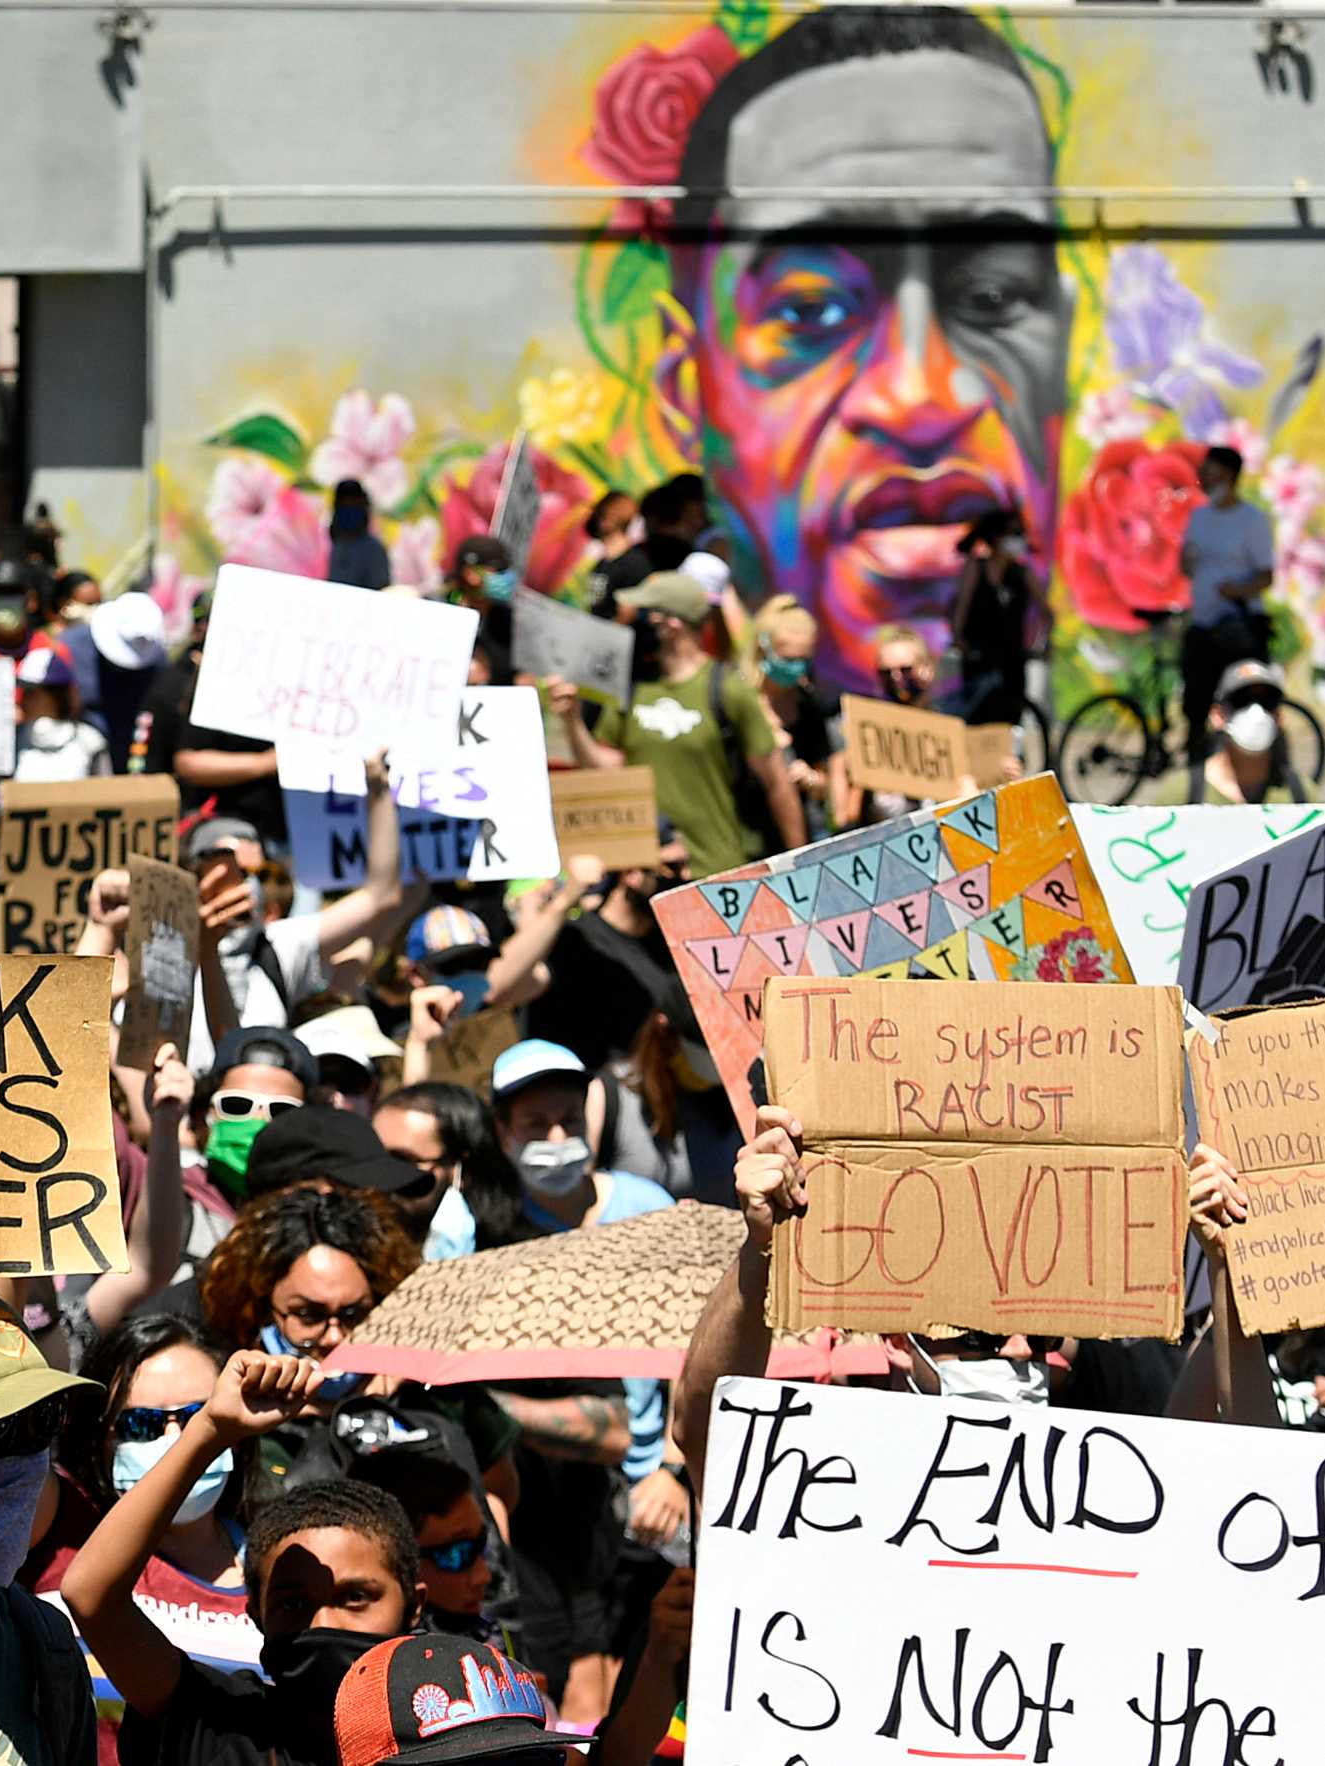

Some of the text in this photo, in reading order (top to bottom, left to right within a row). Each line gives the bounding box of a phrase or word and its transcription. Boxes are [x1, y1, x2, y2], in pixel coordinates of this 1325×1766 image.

[858, 719, 956, 783] ENOUGH
[324, 766, 489, 815] LVES
[330, 817, 508, 881] MTTER
[722, 804, 996, 919] BLACK
[3, 900, 77, 954] BRE
[711, 880, 986, 976] LIVES
[743, 877, 1081, 1022] MTER
[780, 987, 1145, 1086] The system is
[1247, 1032, 1292, 1067] you
[893, 1077, 1075, 1139] RACIST
[1222, 1072, 1321, 1113] makes
[794, 1157, 1179, 1297] GO VOTE!
[1245, 1182, 1295, 1218] black
[710, 1385, 864, 1540] The
[884, 1413, 1166, 1556] END
[723, 1605, 843, 1731] IS
[1126, 1646, 1286, 1766] the
